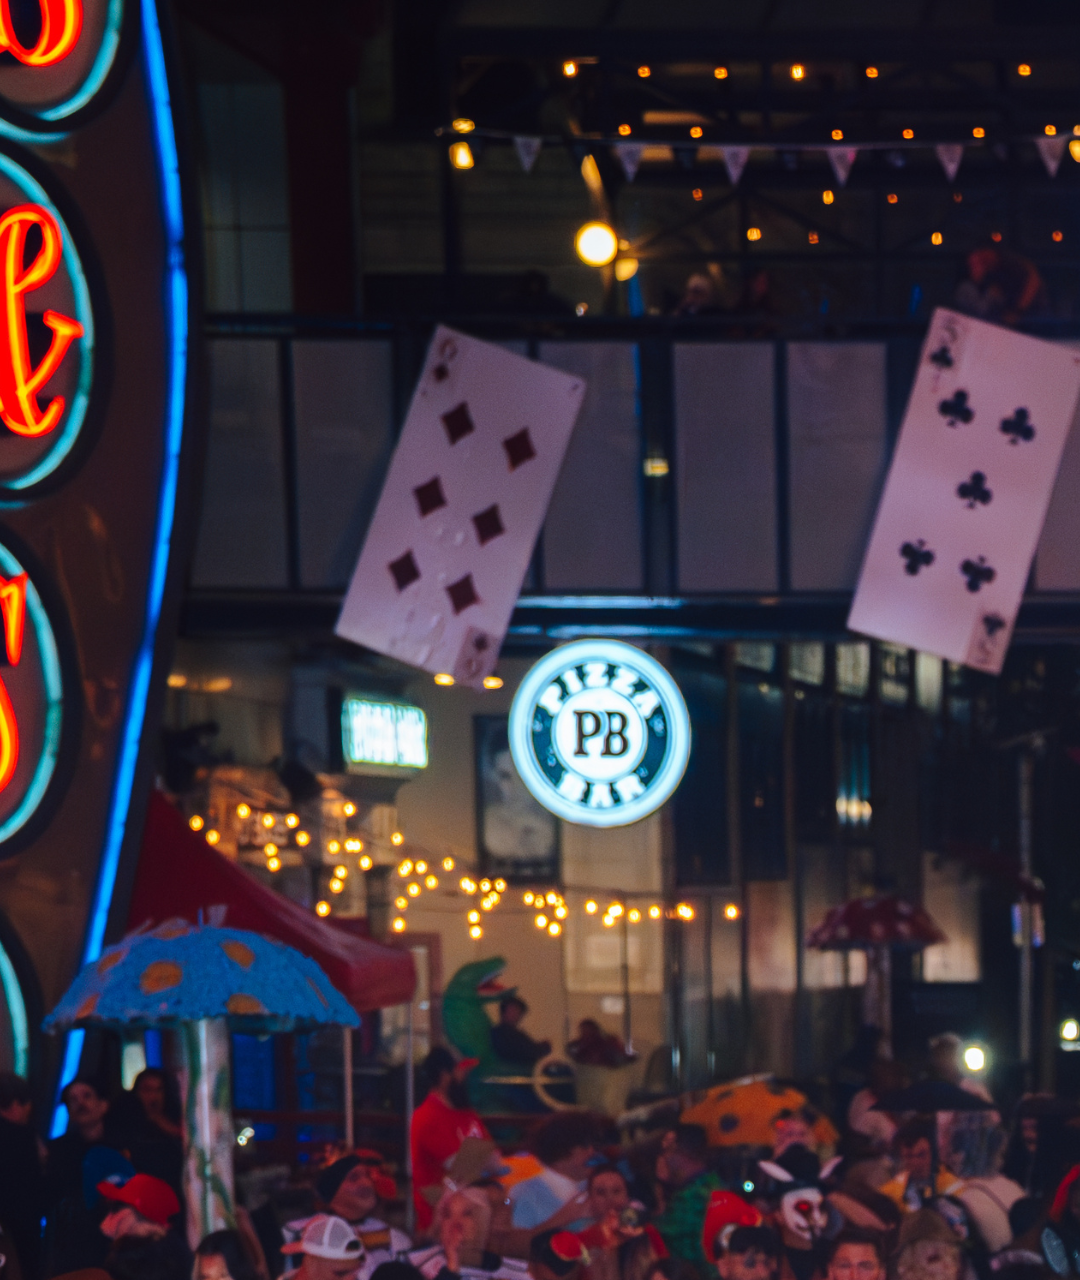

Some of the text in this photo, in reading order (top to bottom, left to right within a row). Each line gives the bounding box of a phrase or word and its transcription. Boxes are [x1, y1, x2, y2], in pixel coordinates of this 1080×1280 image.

[538, 662, 661, 718] PIZZA
[573, 711, 629, 756] PB
[556, 770, 648, 808] BAR
